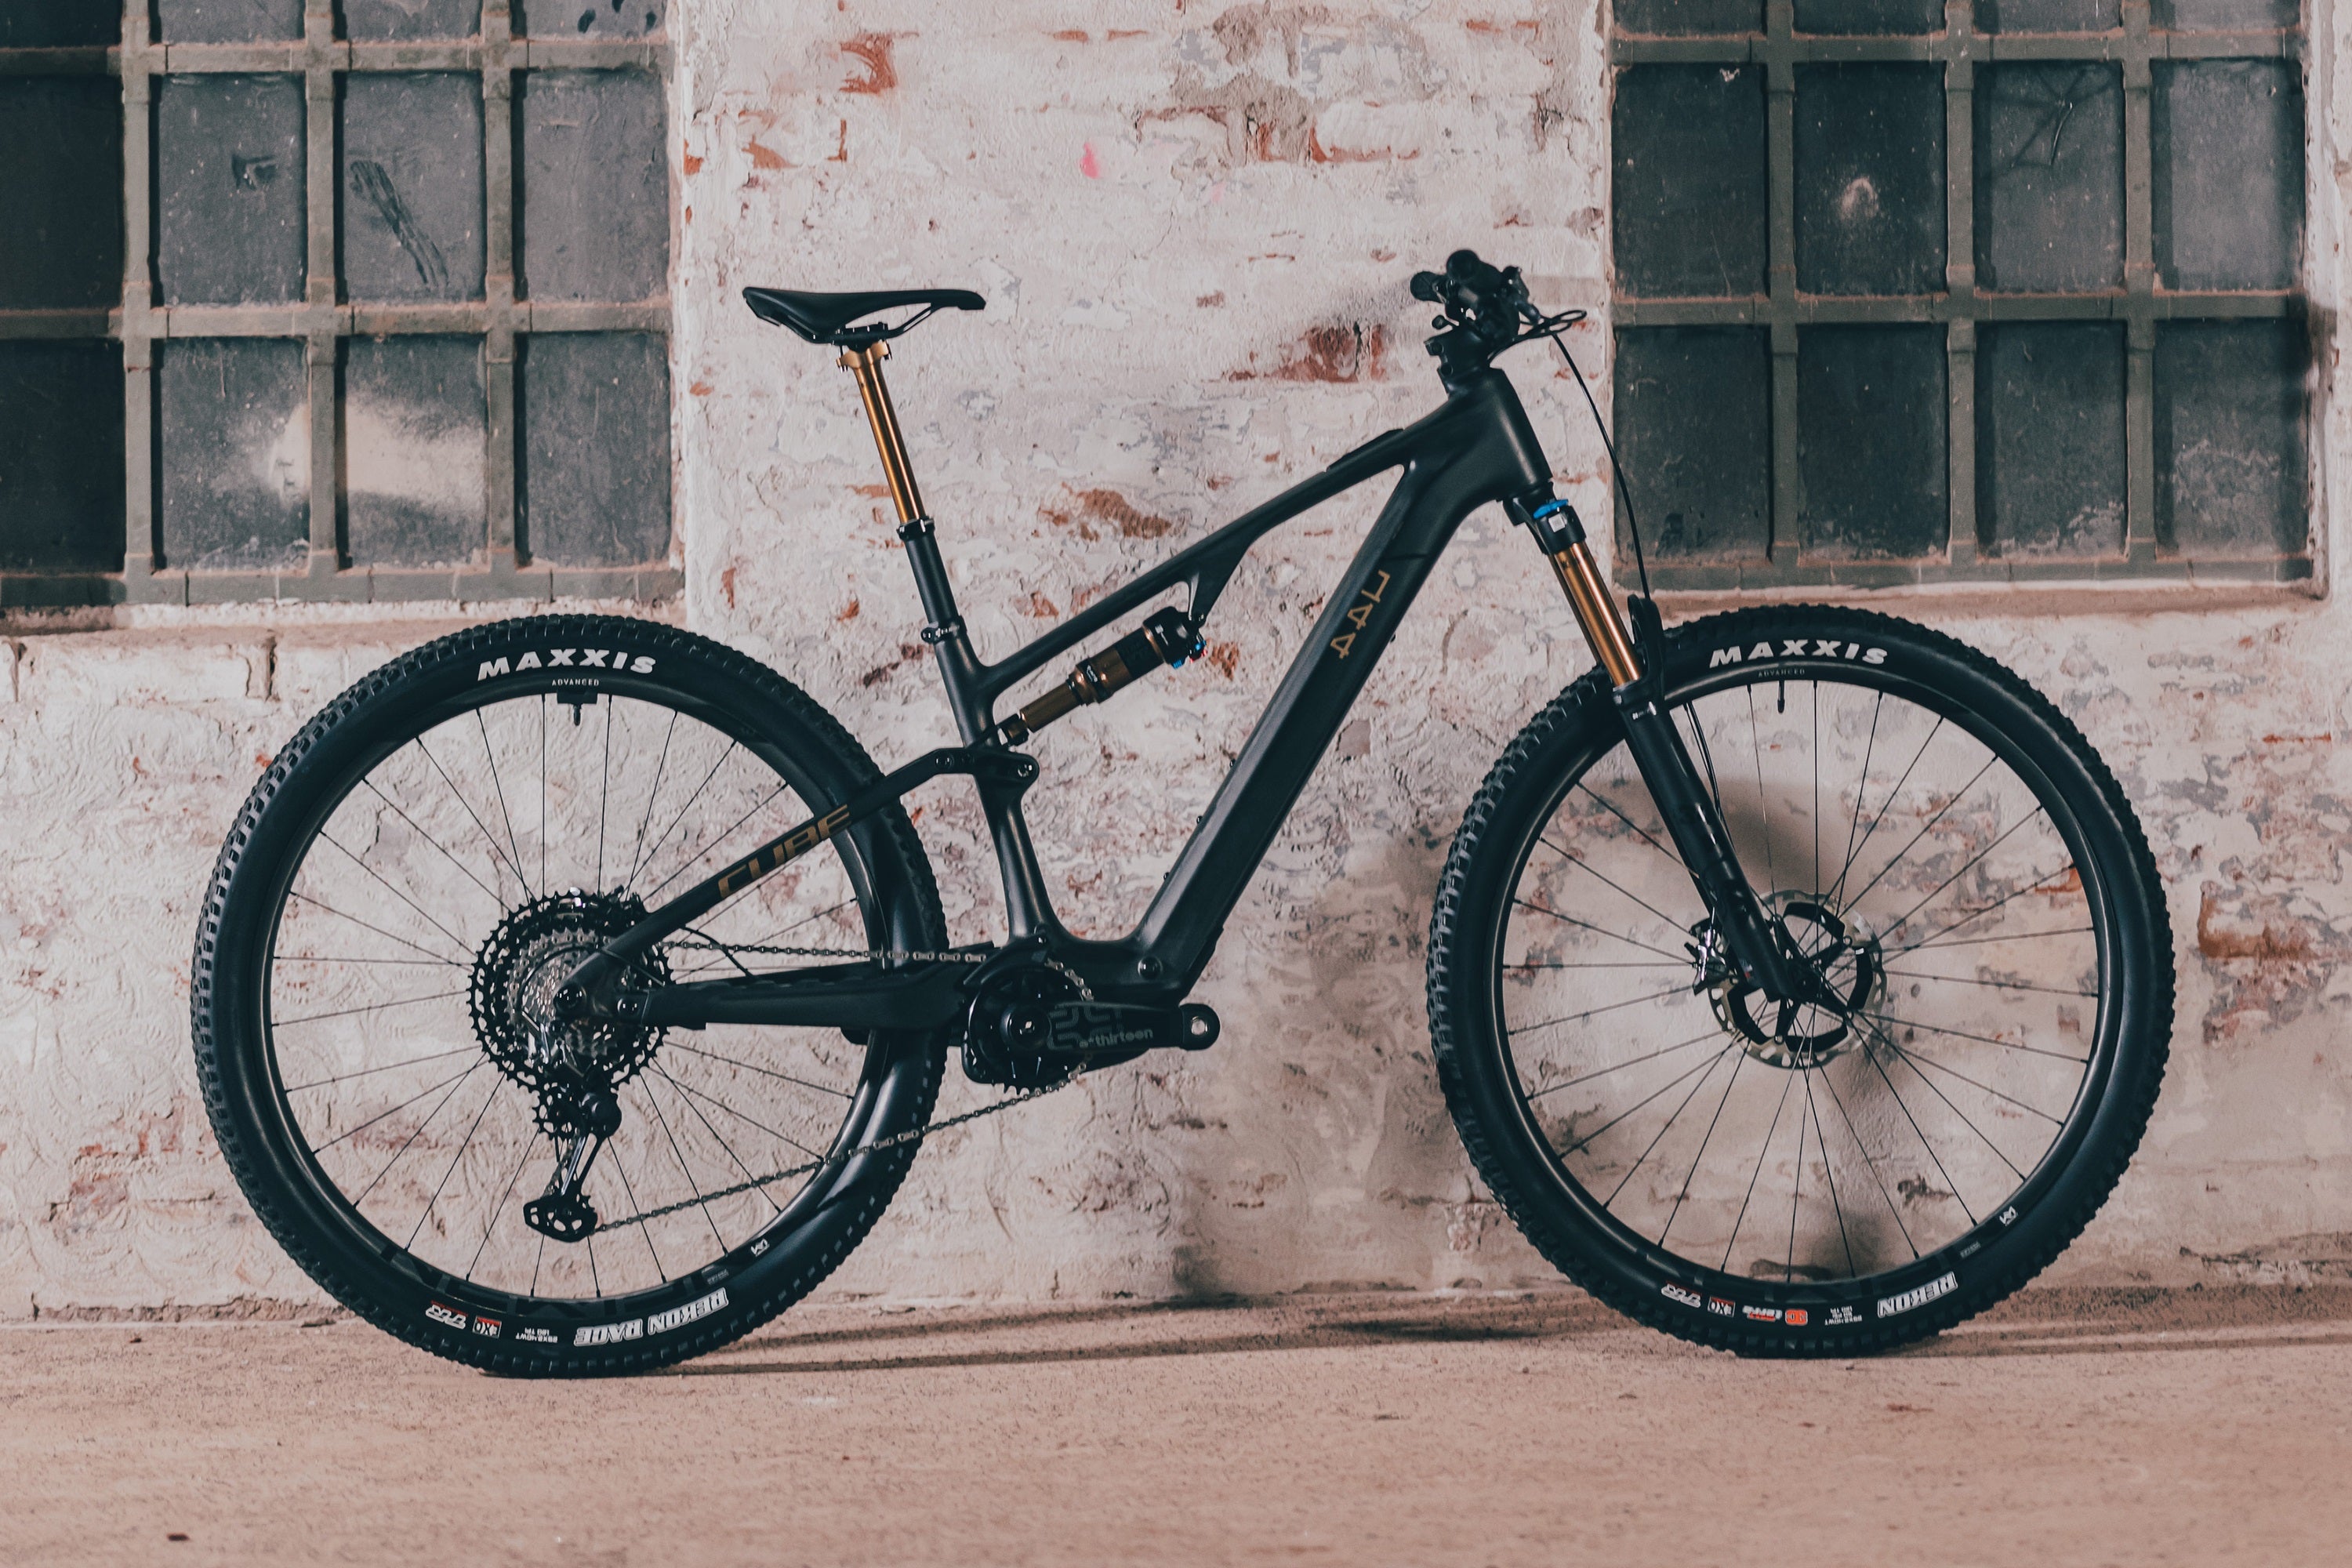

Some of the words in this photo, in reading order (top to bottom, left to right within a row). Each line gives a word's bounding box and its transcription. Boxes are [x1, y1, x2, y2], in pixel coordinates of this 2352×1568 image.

[477, 648, 657, 681] MAXXIS
[1709, 639, 1889, 668] MAXXIS
[551, 678, 600, 687] ADVANCED
[718, 804, 852, 898] CUBE
[647, 1287, 729, 1336] REKON
[1877, 1271, 1958, 1319] REKON
[474, 1319, 501, 1338] EXO
